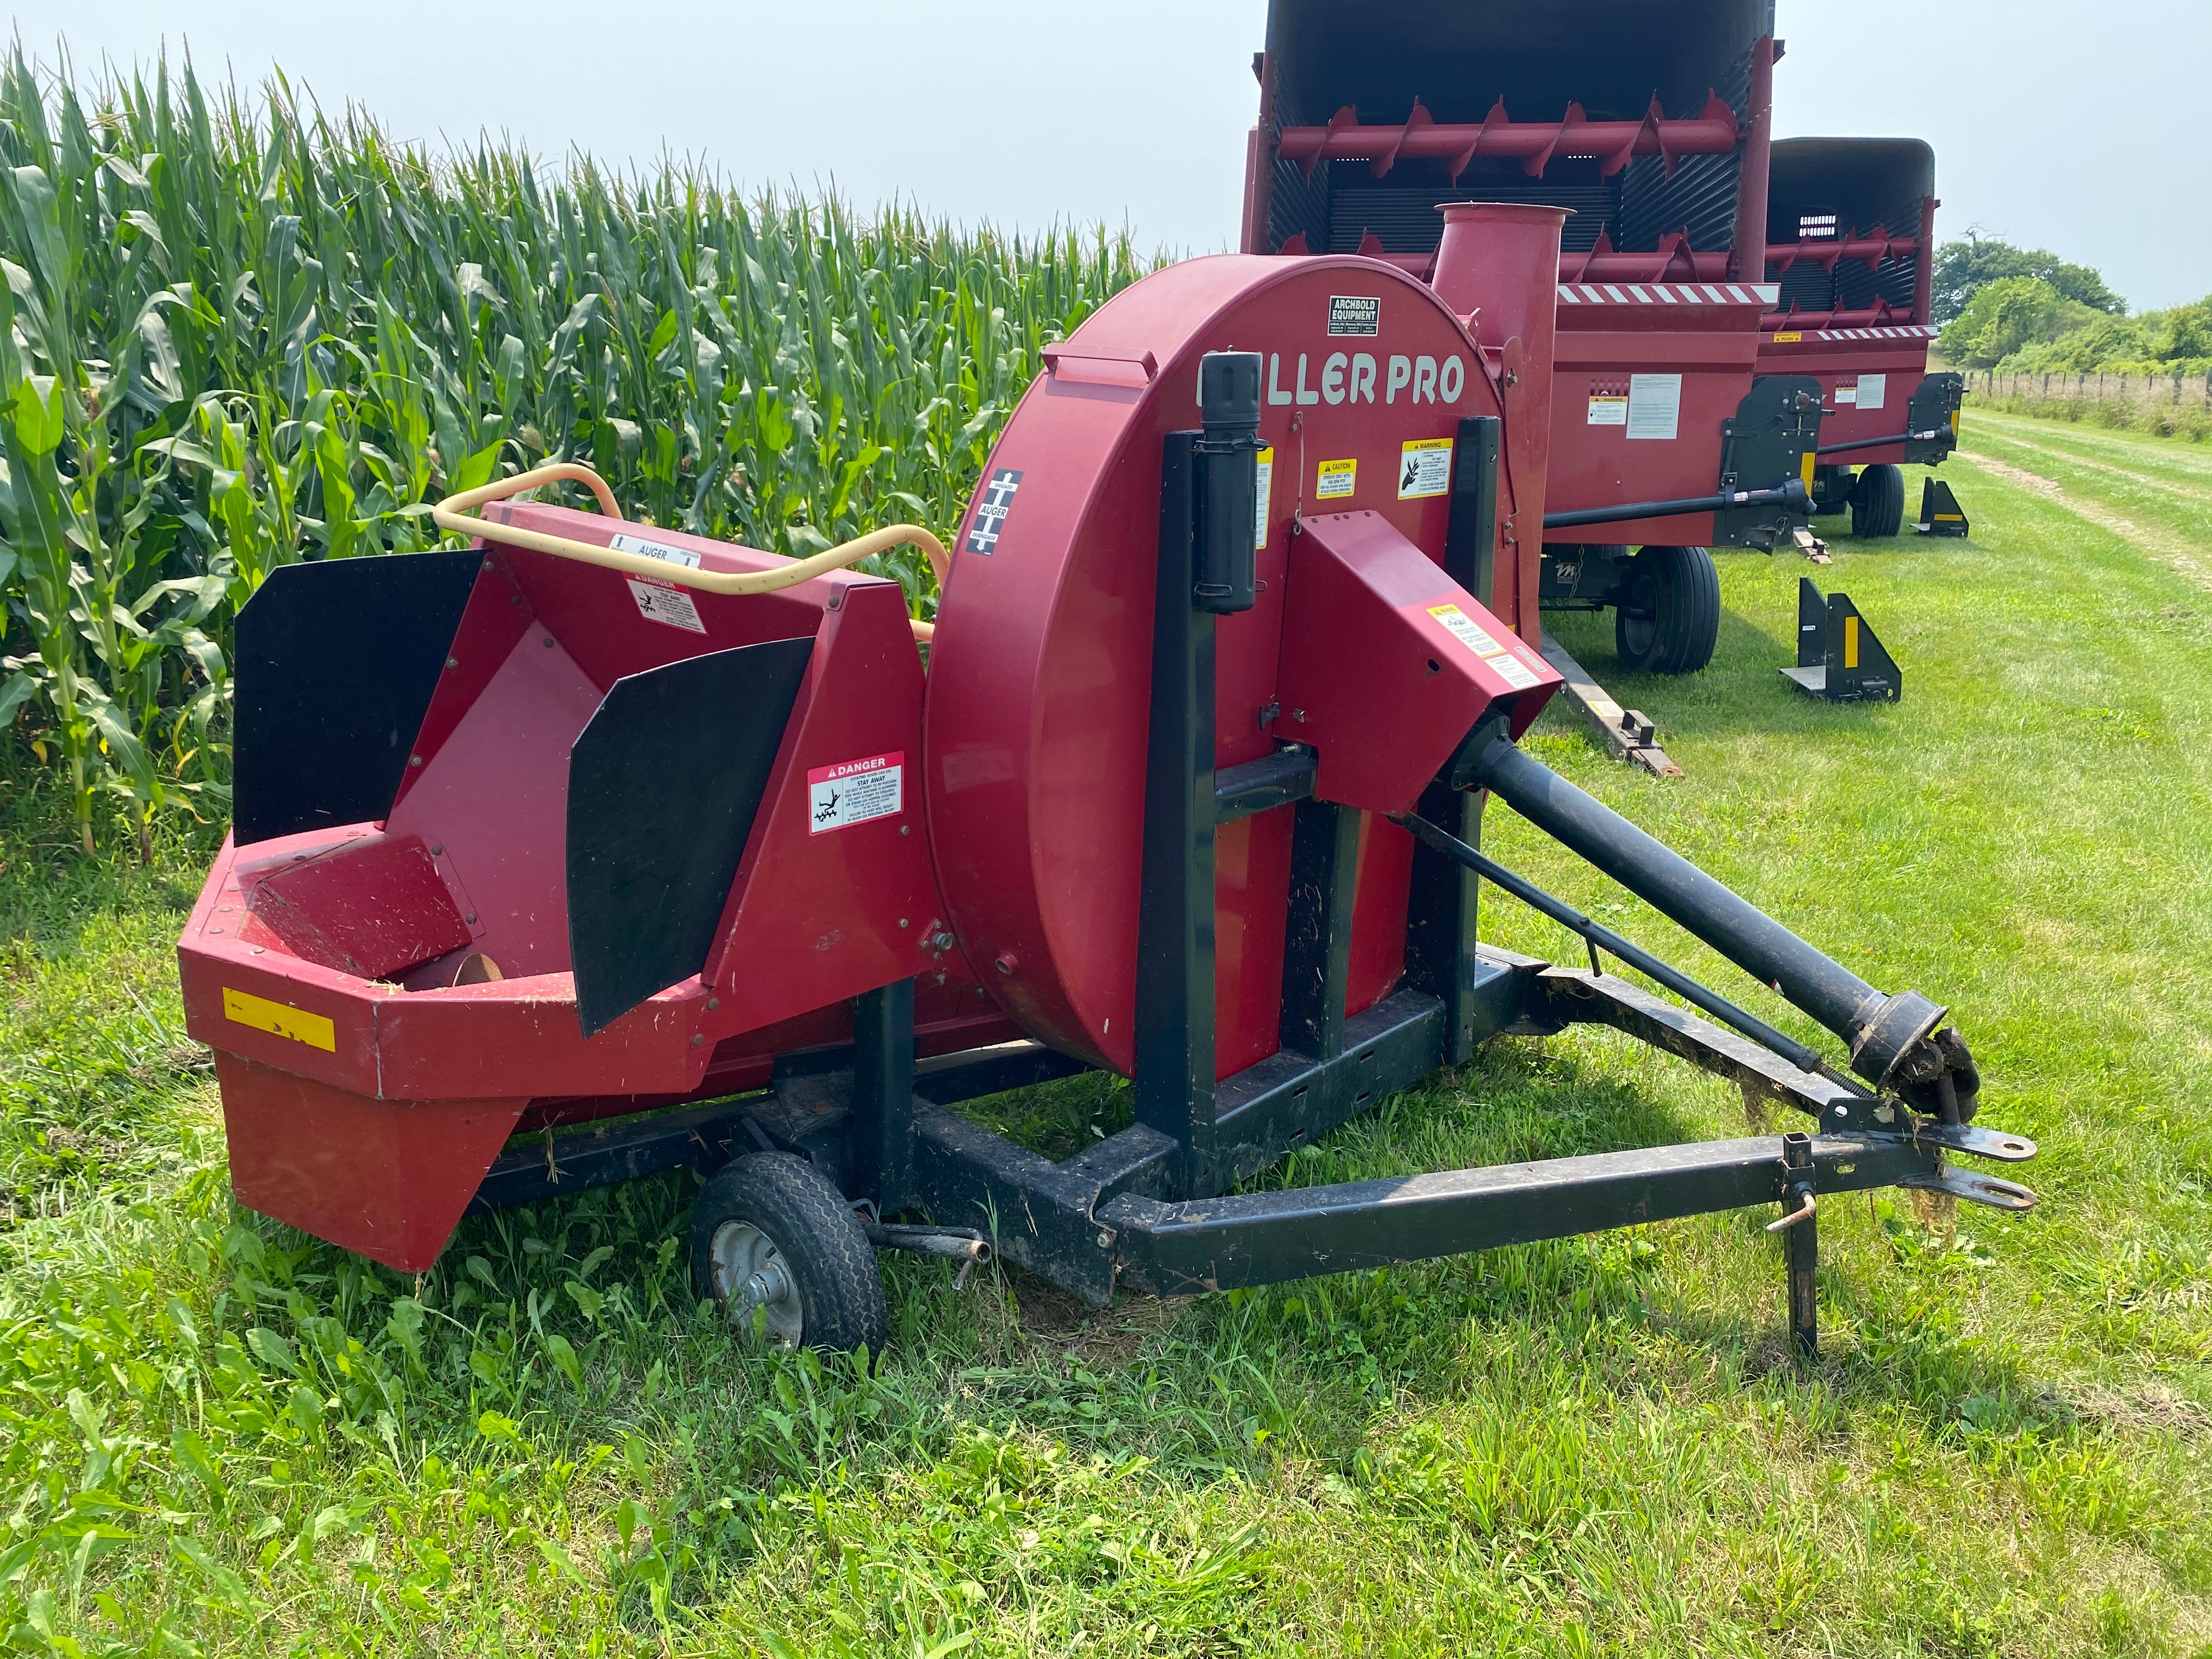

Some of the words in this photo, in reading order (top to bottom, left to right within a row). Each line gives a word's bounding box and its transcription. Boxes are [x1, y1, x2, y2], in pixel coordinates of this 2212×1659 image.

[1334, 299, 1375, 310] ARCHBOLD
[1332, 309, 1376, 320] EQUIPMENT
[1196, 350, 1376, 407] LLER
[1386, 354, 1464, 404] PRO
[980, 505, 1007, 517] AUGER
[972, 532, 996, 541] DISENGAGE
[638, 545, 668, 560] AUGER
[640, 575, 676, 589] DANGER
[838, 758, 885, 776] DANGER
[871, 775, 885, 783] AWAY
